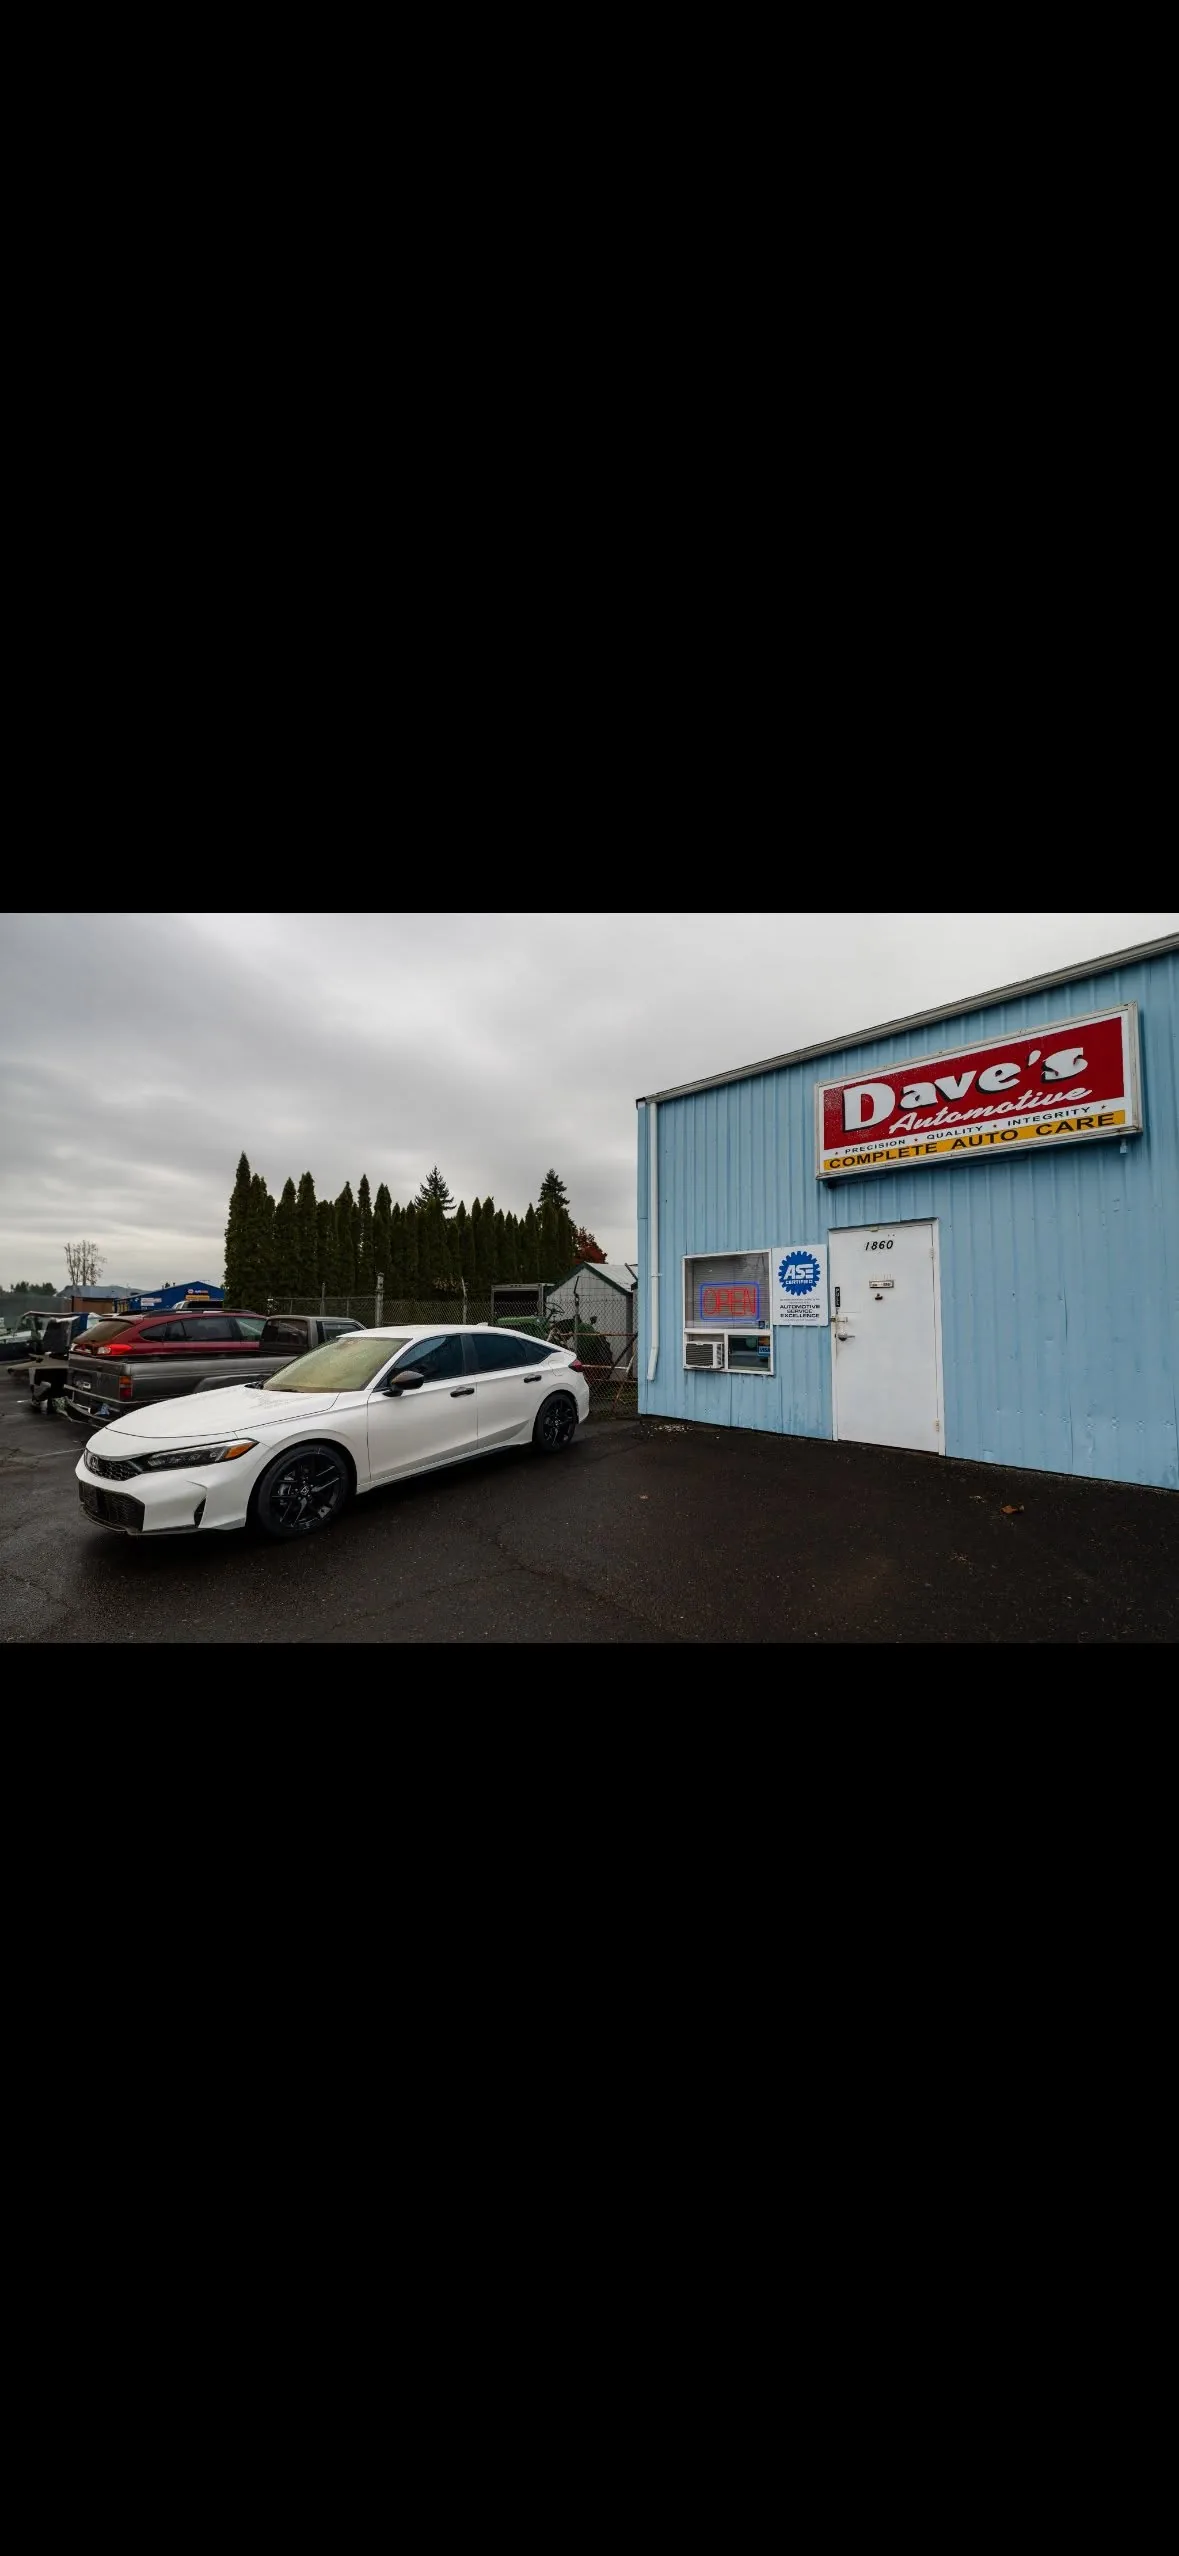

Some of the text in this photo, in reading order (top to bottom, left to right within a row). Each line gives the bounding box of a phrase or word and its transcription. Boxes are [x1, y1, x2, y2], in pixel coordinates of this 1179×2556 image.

[843, 1047, 1088, 1132] Dave's
[889, 1087, 1092, 1134] Automotive
[829, 1112, 1115, 1169] COMPLETE AUTO CARE
[845, 1106, 1090, 1154] PRECISION QUALITY INTEGRITY
[865, 1239, 894, 1251] 1860
[784, 1263, 814, 1280] ASE
[703, 1287, 757, 1315] OPEN
